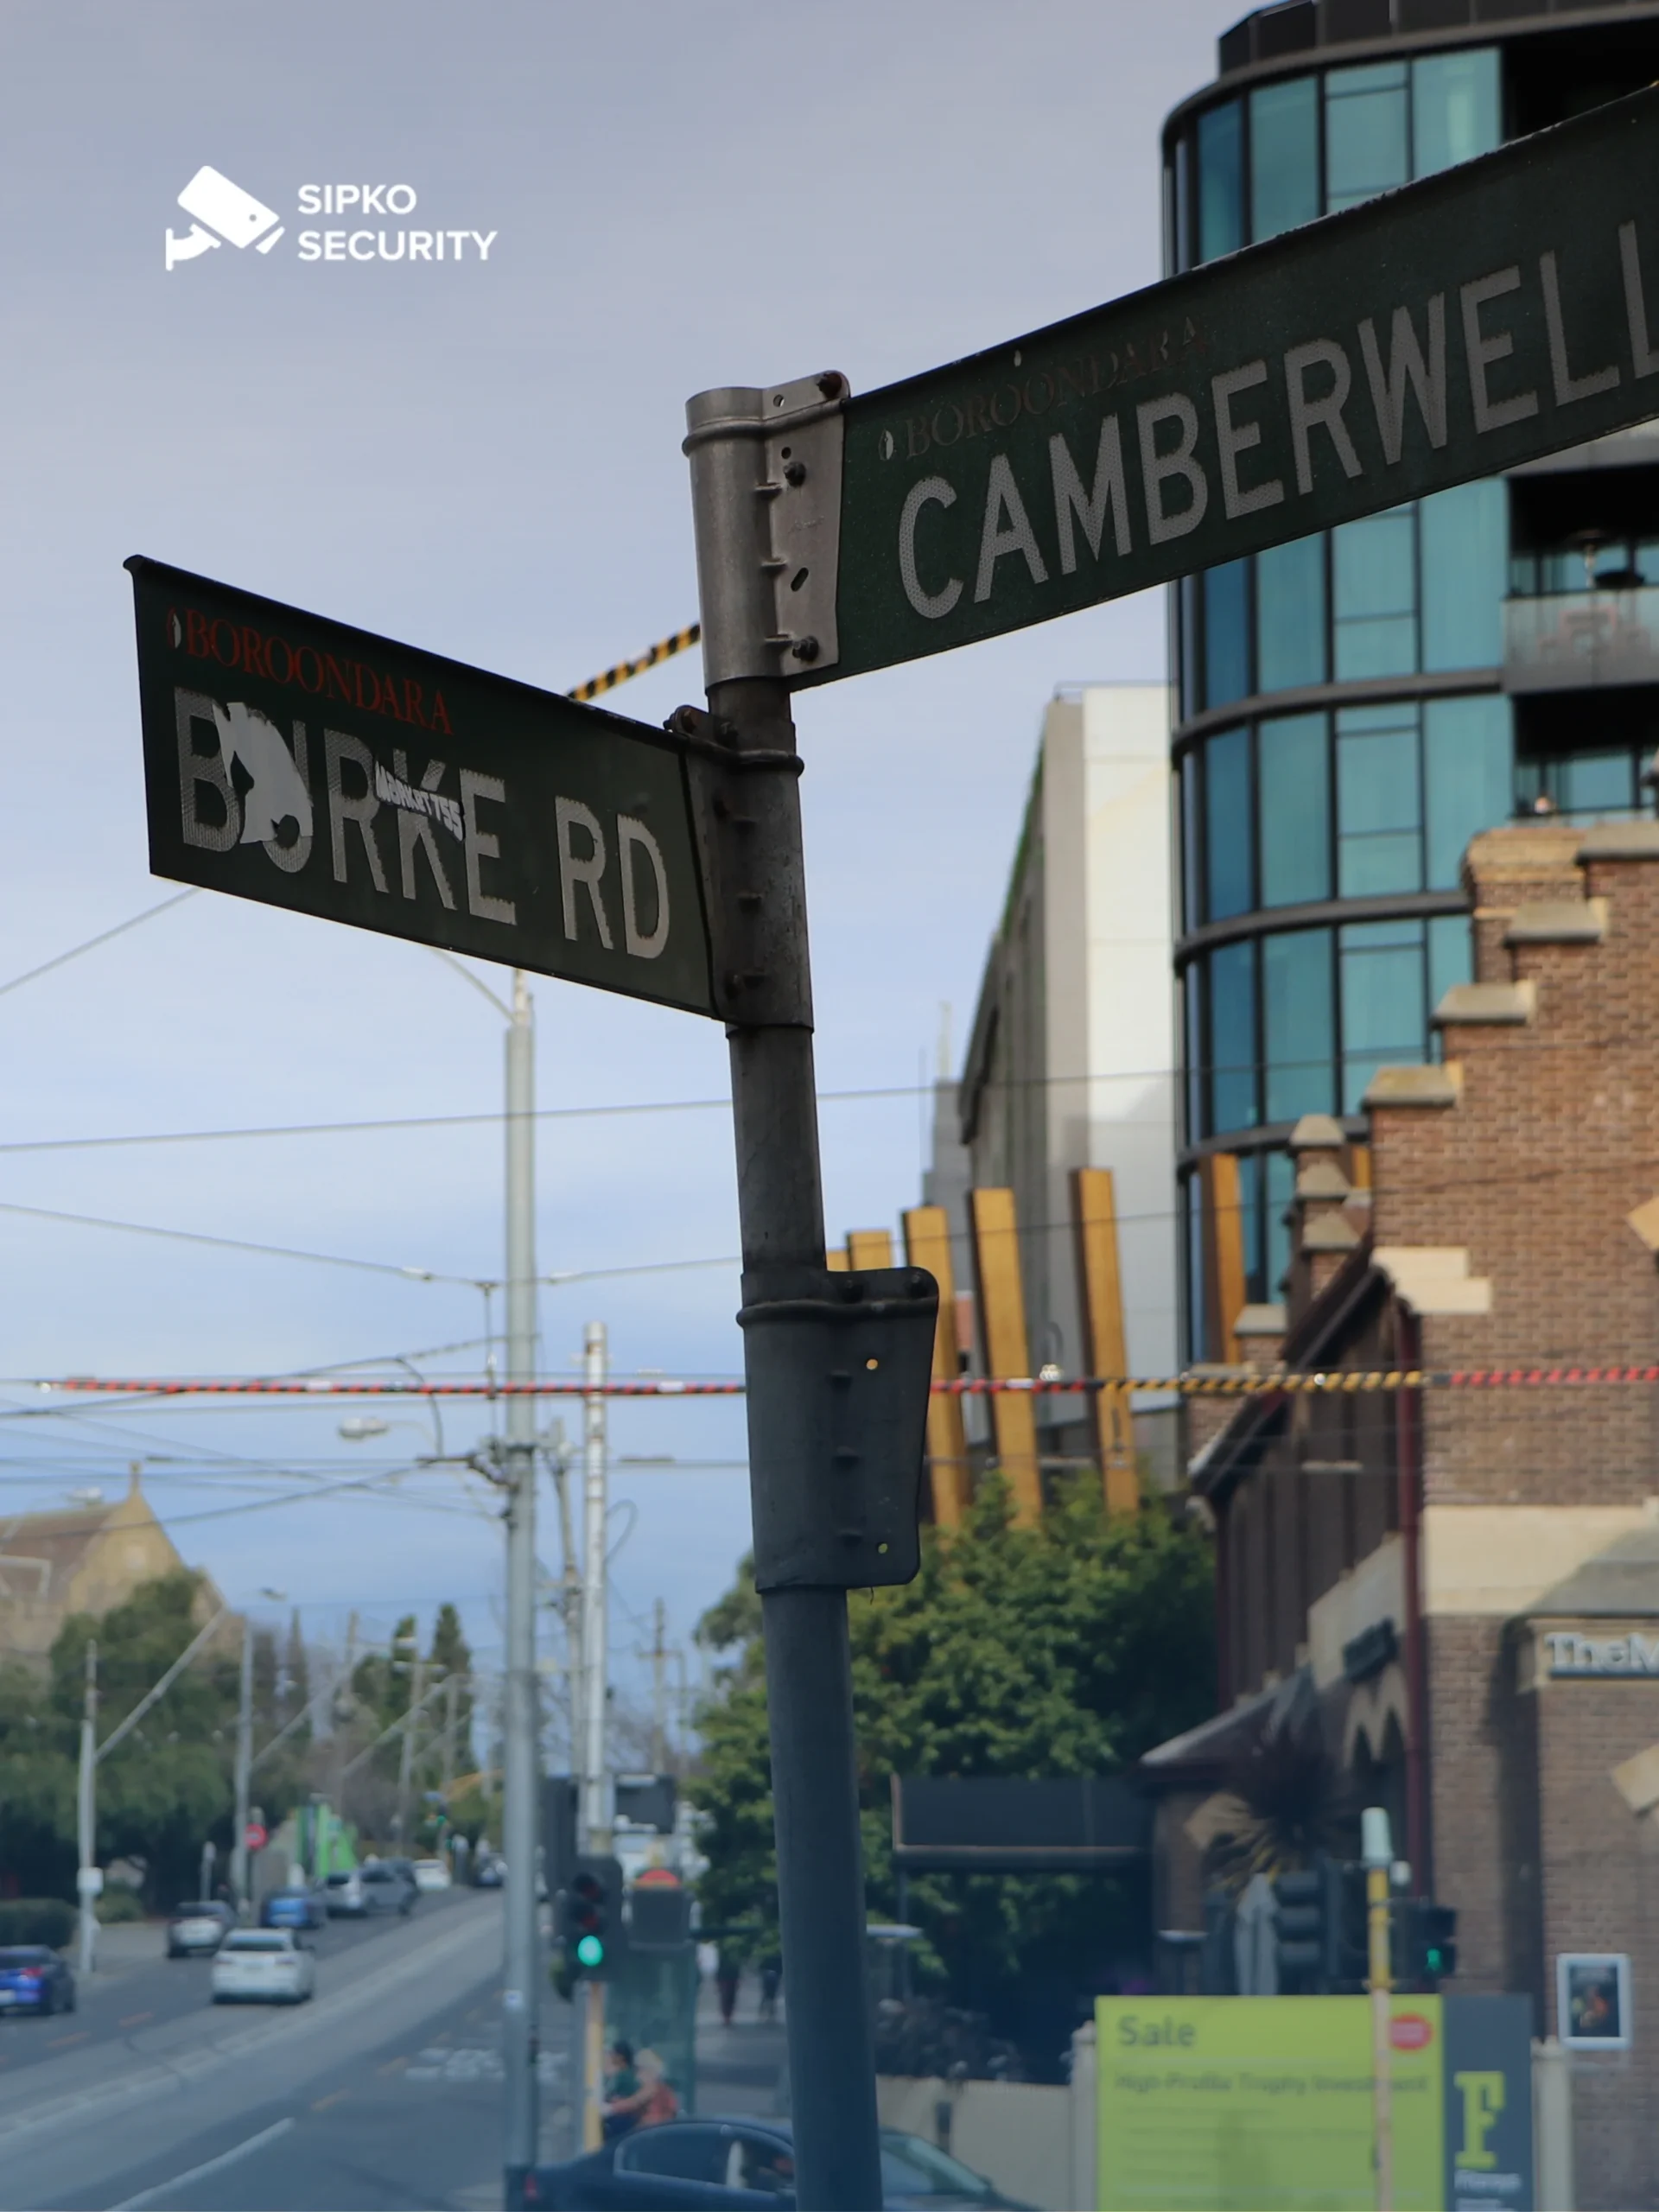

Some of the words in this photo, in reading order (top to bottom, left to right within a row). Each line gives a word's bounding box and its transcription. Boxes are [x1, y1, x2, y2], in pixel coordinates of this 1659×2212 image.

[899, 220, 1659, 619] CAMBERWELL
[906, 316, 1207, 458] BOROONDARA
[185, 607, 454, 735] BOROONDARA
[555, 796, 670, 959] RD
[1117, 2014, 1198, 2048] Sale
[1454, 2070, 1506, 2171] F
